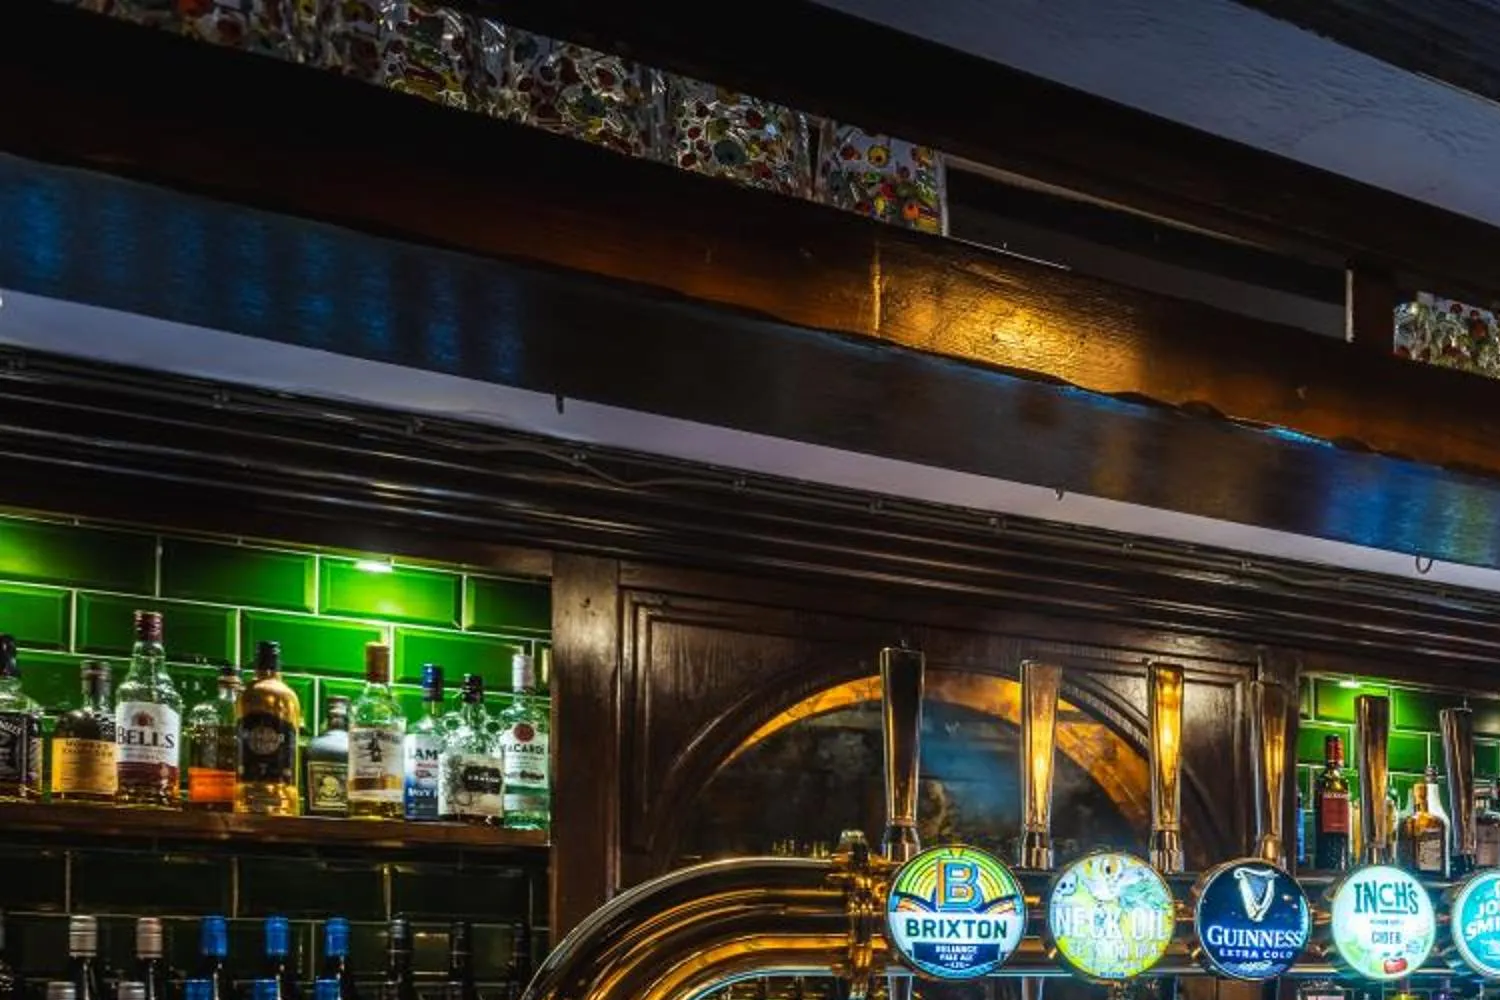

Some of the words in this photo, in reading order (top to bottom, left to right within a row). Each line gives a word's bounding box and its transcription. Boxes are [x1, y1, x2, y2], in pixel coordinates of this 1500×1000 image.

[905, 918, 1008, 939] BRIXTON
[1054, 906, 1124, 939] NECK
[1131, 906, 1169, 941] OIL
[1206, 925, 1304, 949] GUINNESS
[1218, 948, 1260, 959] EXTRA
[1262, 949, 1294, 960] COLD
